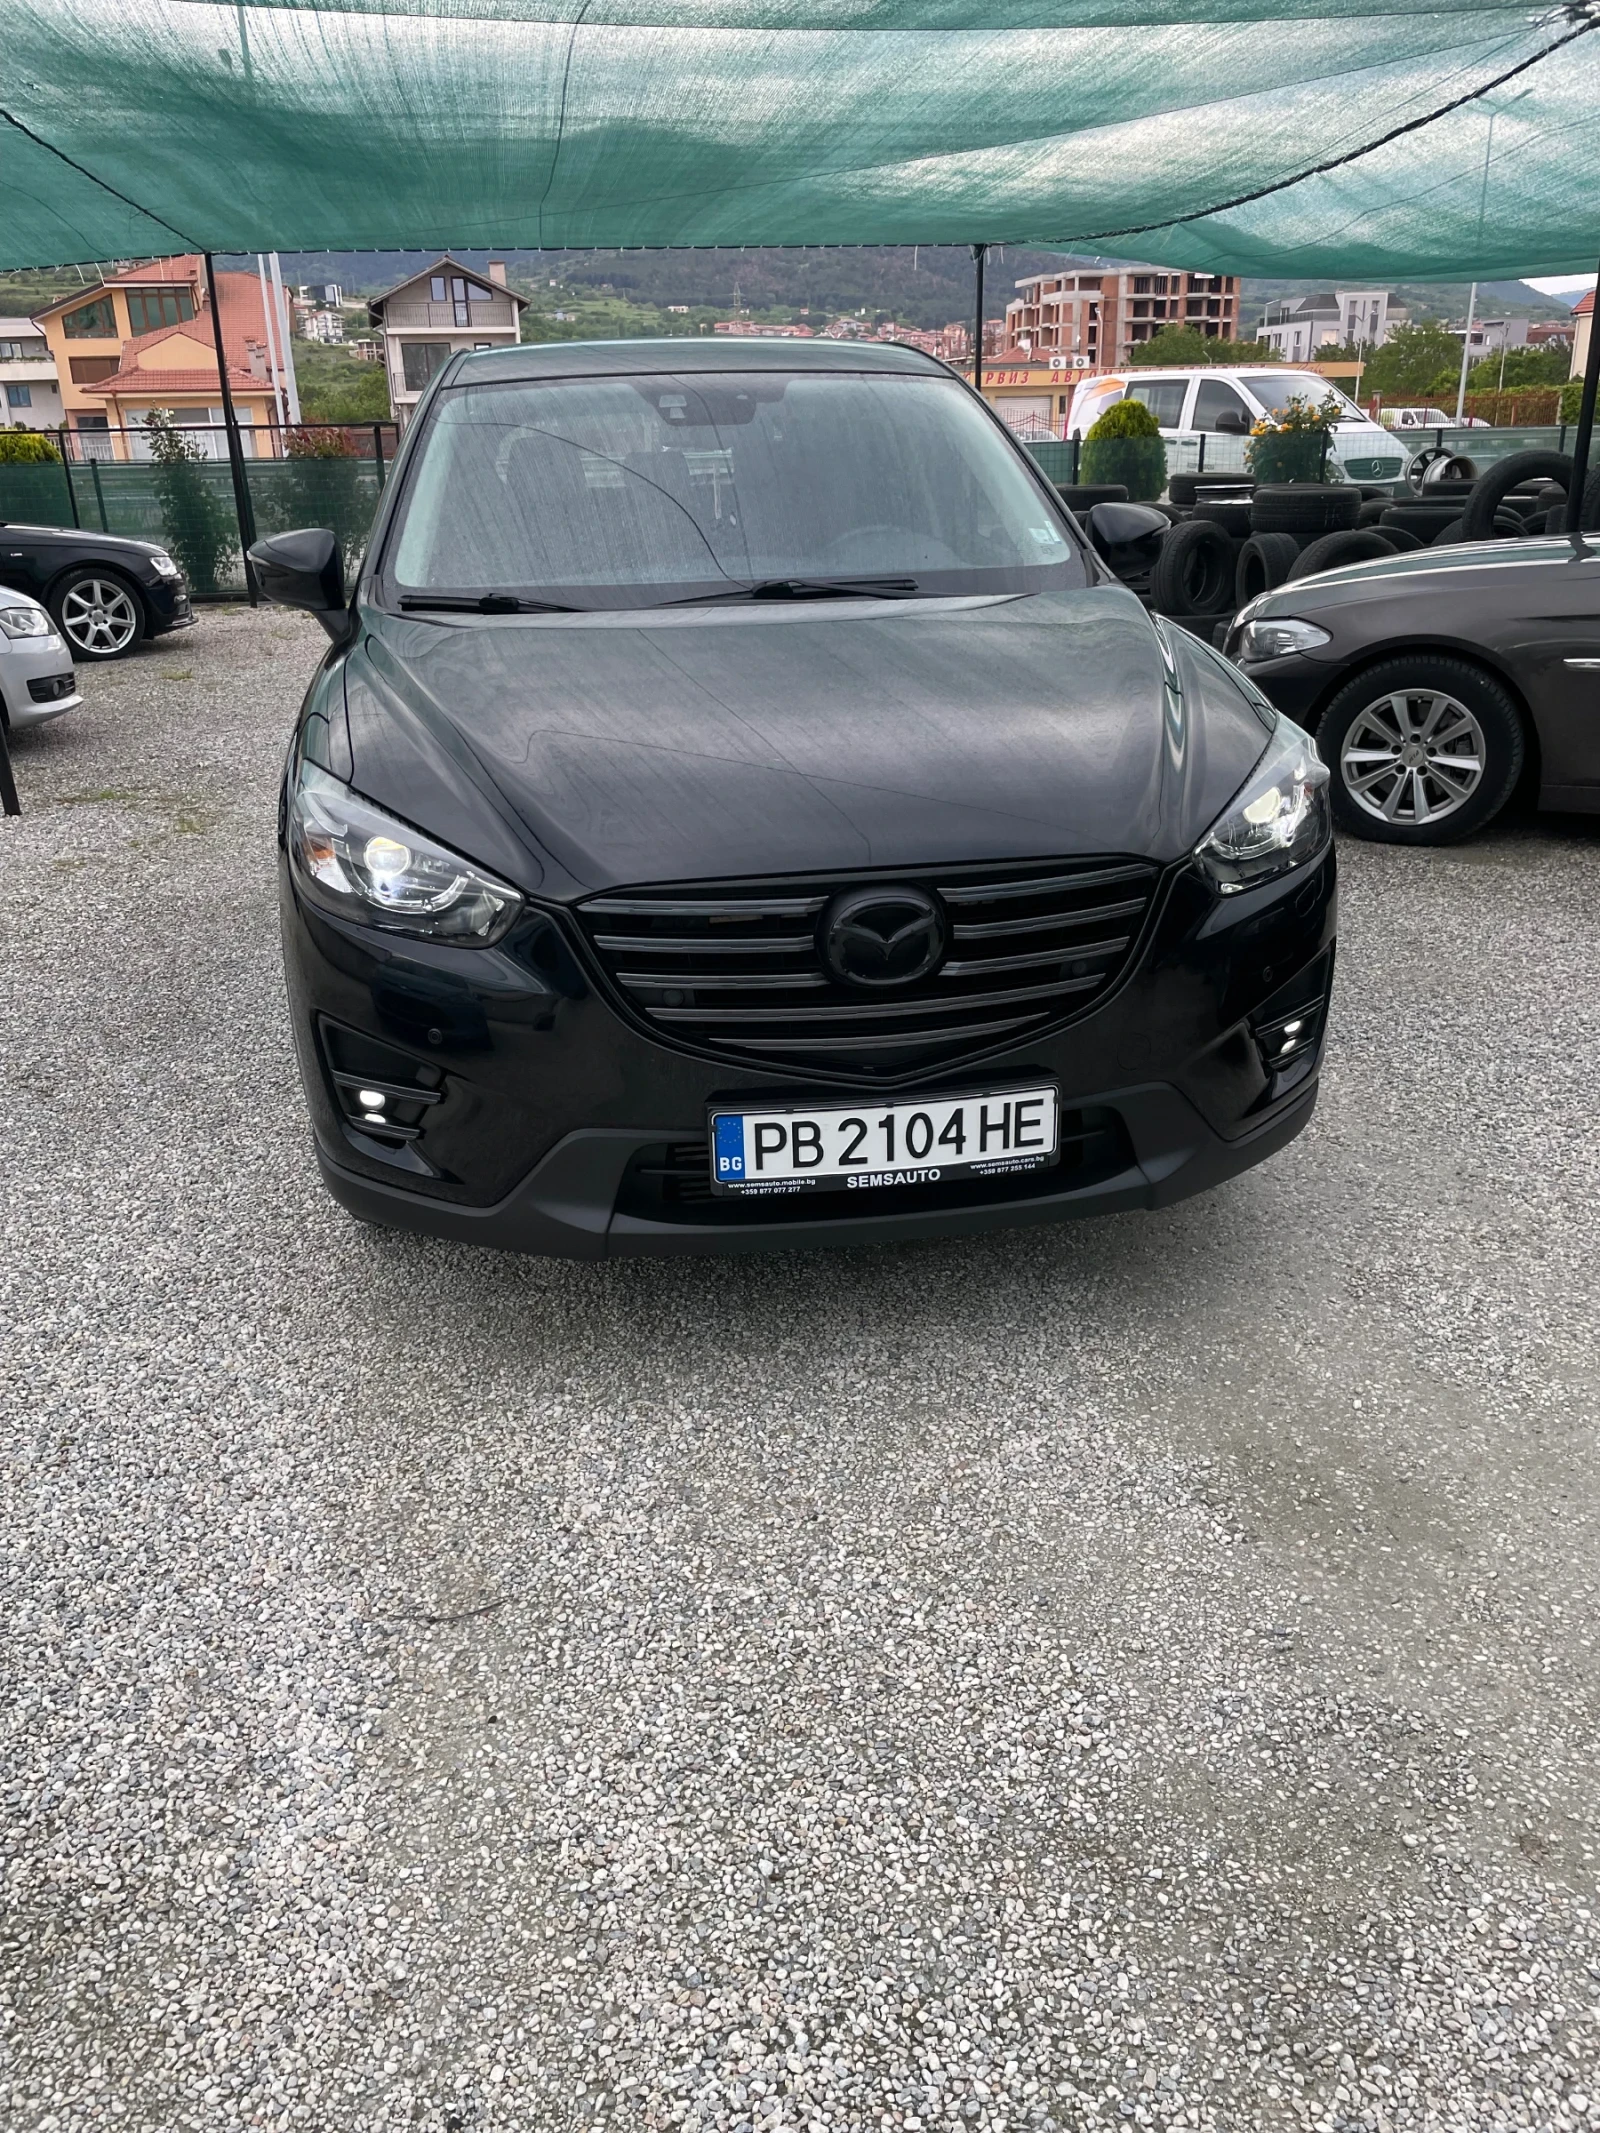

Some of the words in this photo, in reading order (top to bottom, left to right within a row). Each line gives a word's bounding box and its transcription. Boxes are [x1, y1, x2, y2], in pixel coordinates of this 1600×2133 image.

[963, 371, 1029, 384] СРВИЗ
[754, 1121, 824, 1170] PB
[838, 1108, 966, 1166] 2104
[980, 1099, 1044, 1152] HE
[720, 1157, 742, 1171] BG
[970, 1156, 1045, 1169] www.semsauto.cars.bg
[728, 1178, 816, 1188] www.semsauto.mobile.bg
[847, 1169, 941, 1188] SEMSAUTO
